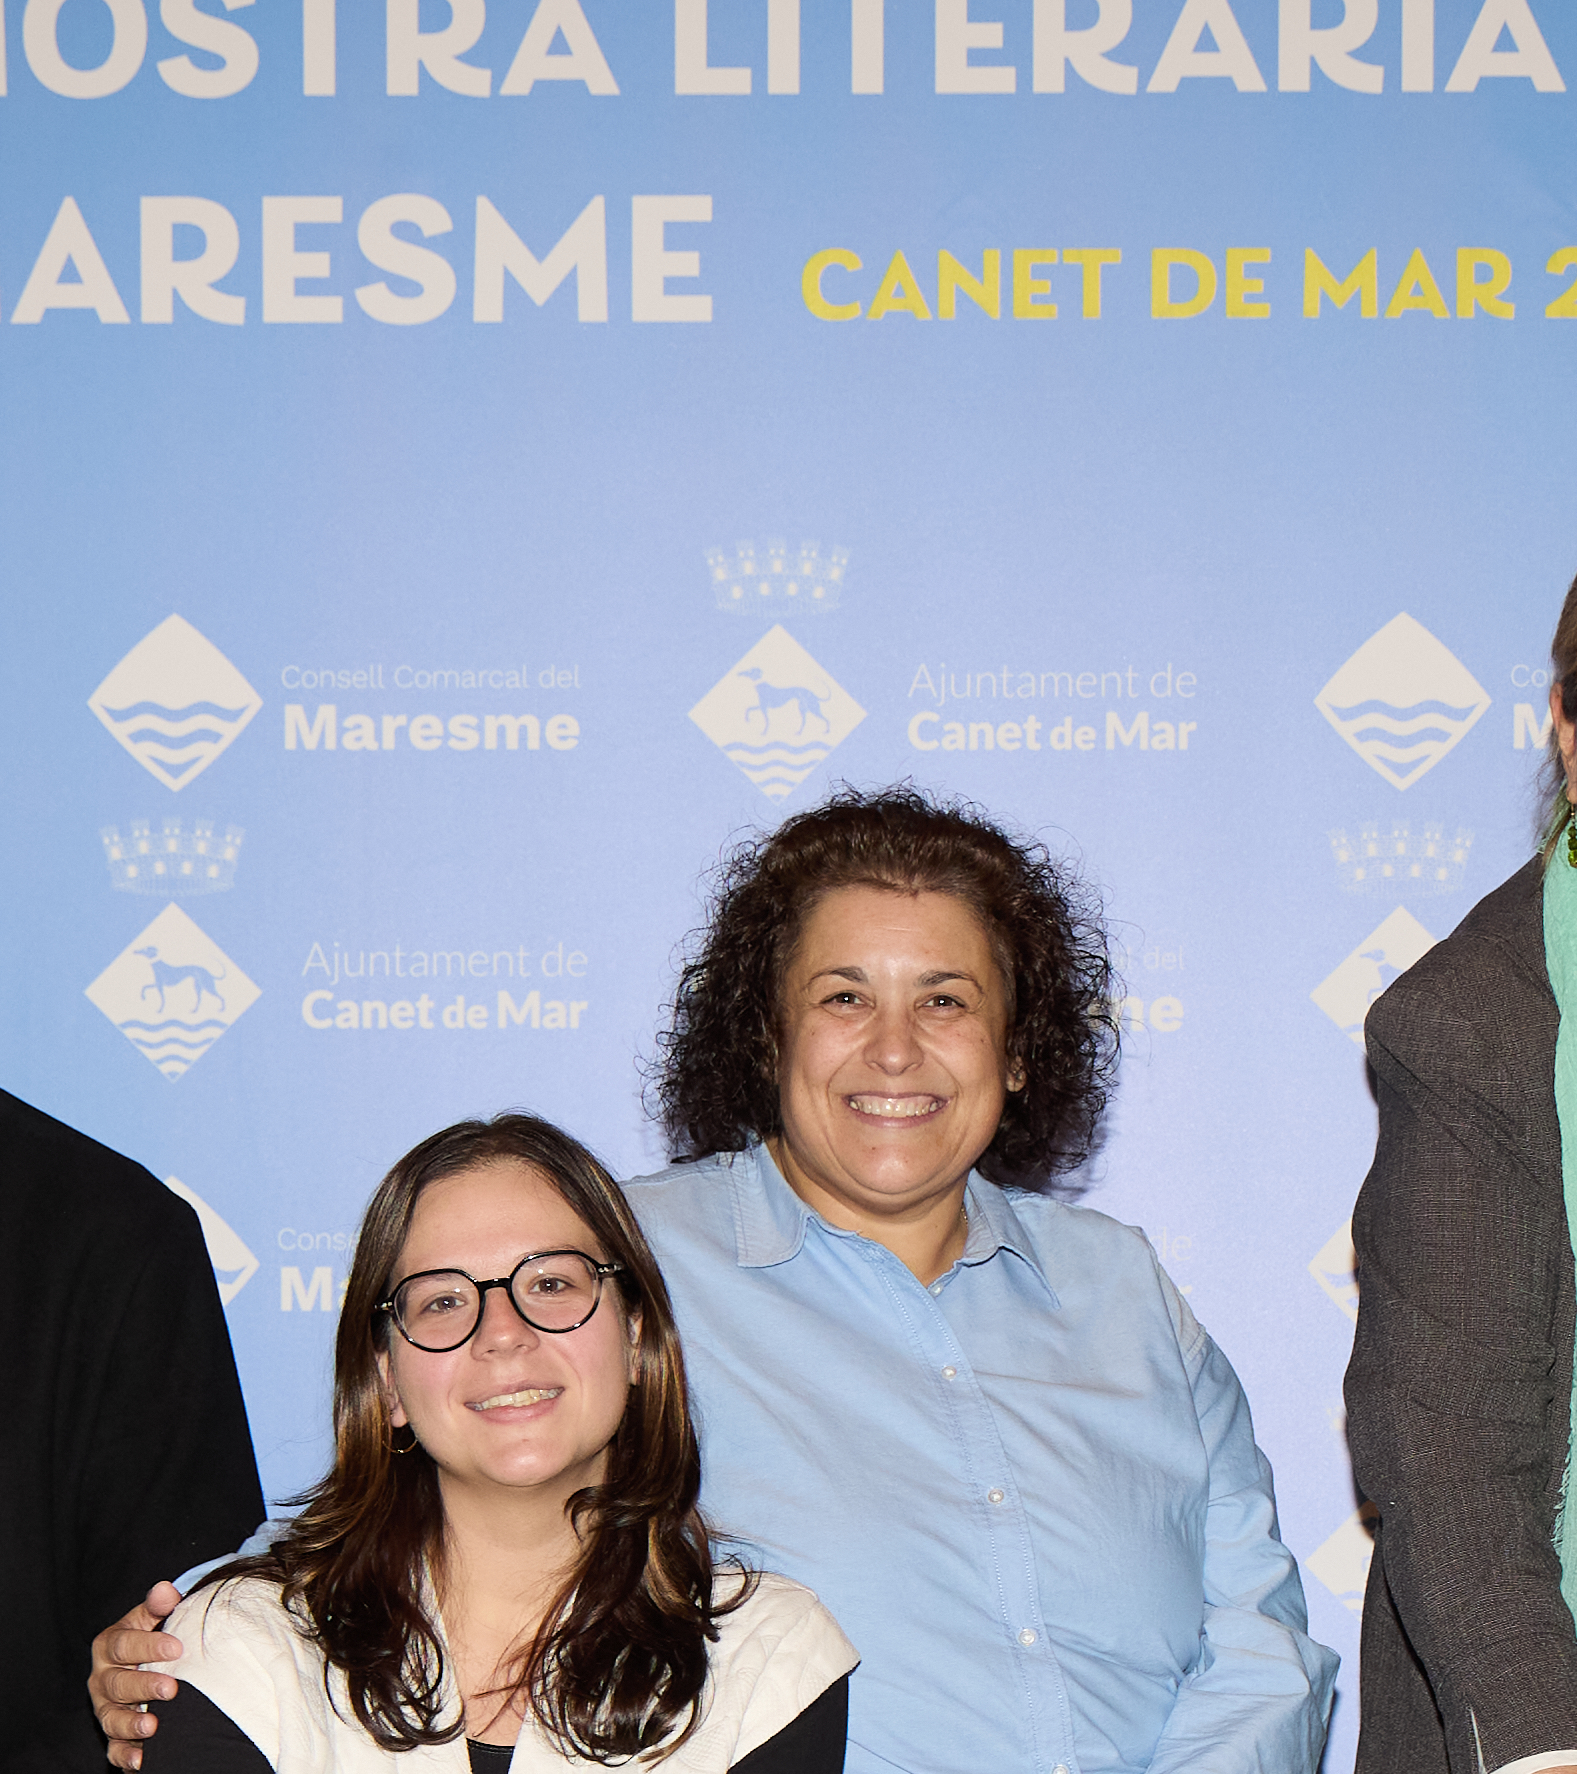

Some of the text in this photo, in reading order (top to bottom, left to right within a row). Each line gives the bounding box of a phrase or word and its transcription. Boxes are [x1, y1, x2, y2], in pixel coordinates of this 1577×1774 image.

[801, 247, 1122, 321] CANET
[1150, 247, 1271, 319] DE
[1302, 247, 1515, 320] MAR
[280, 663, 582, 690] Consell Comarcal del
[907, 662, 1198, 706] Ajuntament de
[284, 703, 581, 751] Maresme
[907, 710, 1198, 752] Canet de Mar
[301, 940, 589, 984] Ajuntament de
[301, 989, 589, 1030] Canet de Mar
[277, 1227, 358, 1252] Cons
